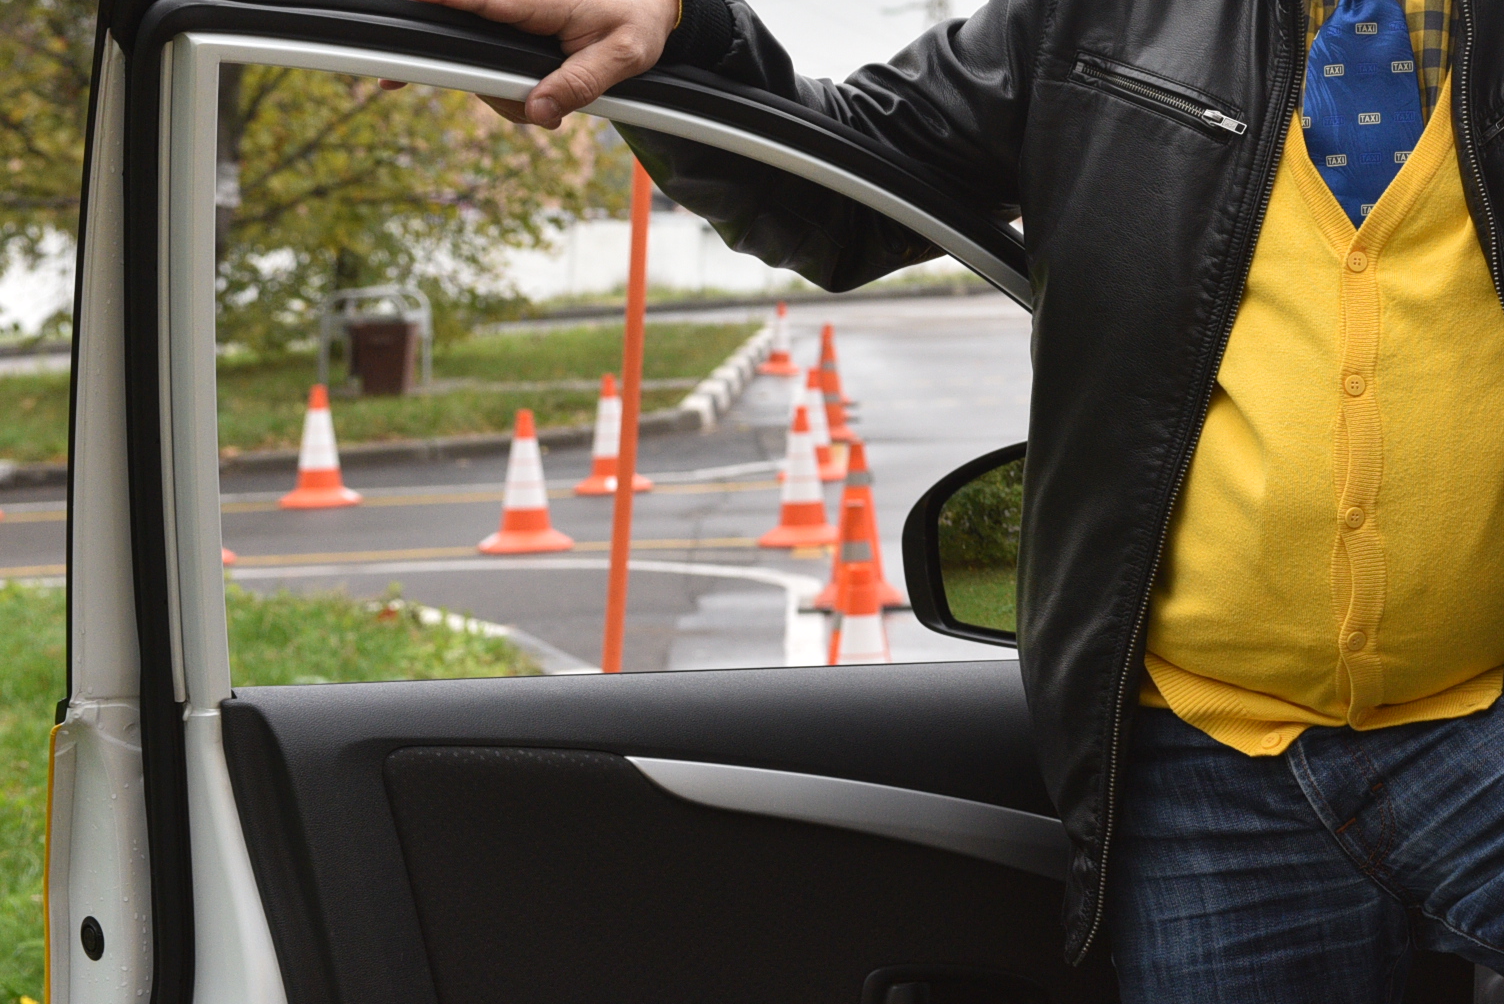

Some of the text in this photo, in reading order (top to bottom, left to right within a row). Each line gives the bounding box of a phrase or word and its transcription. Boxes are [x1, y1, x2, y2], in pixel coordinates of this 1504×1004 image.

[1357, 24, 1376, 32] TAXI
[1325, 66, 1343, 75] TAXI
[1393, 62, 1412, 71] TAXI
[1360, 114, 1379, 123] TAXI
[1327, 156, 1345, 165] TAXI
